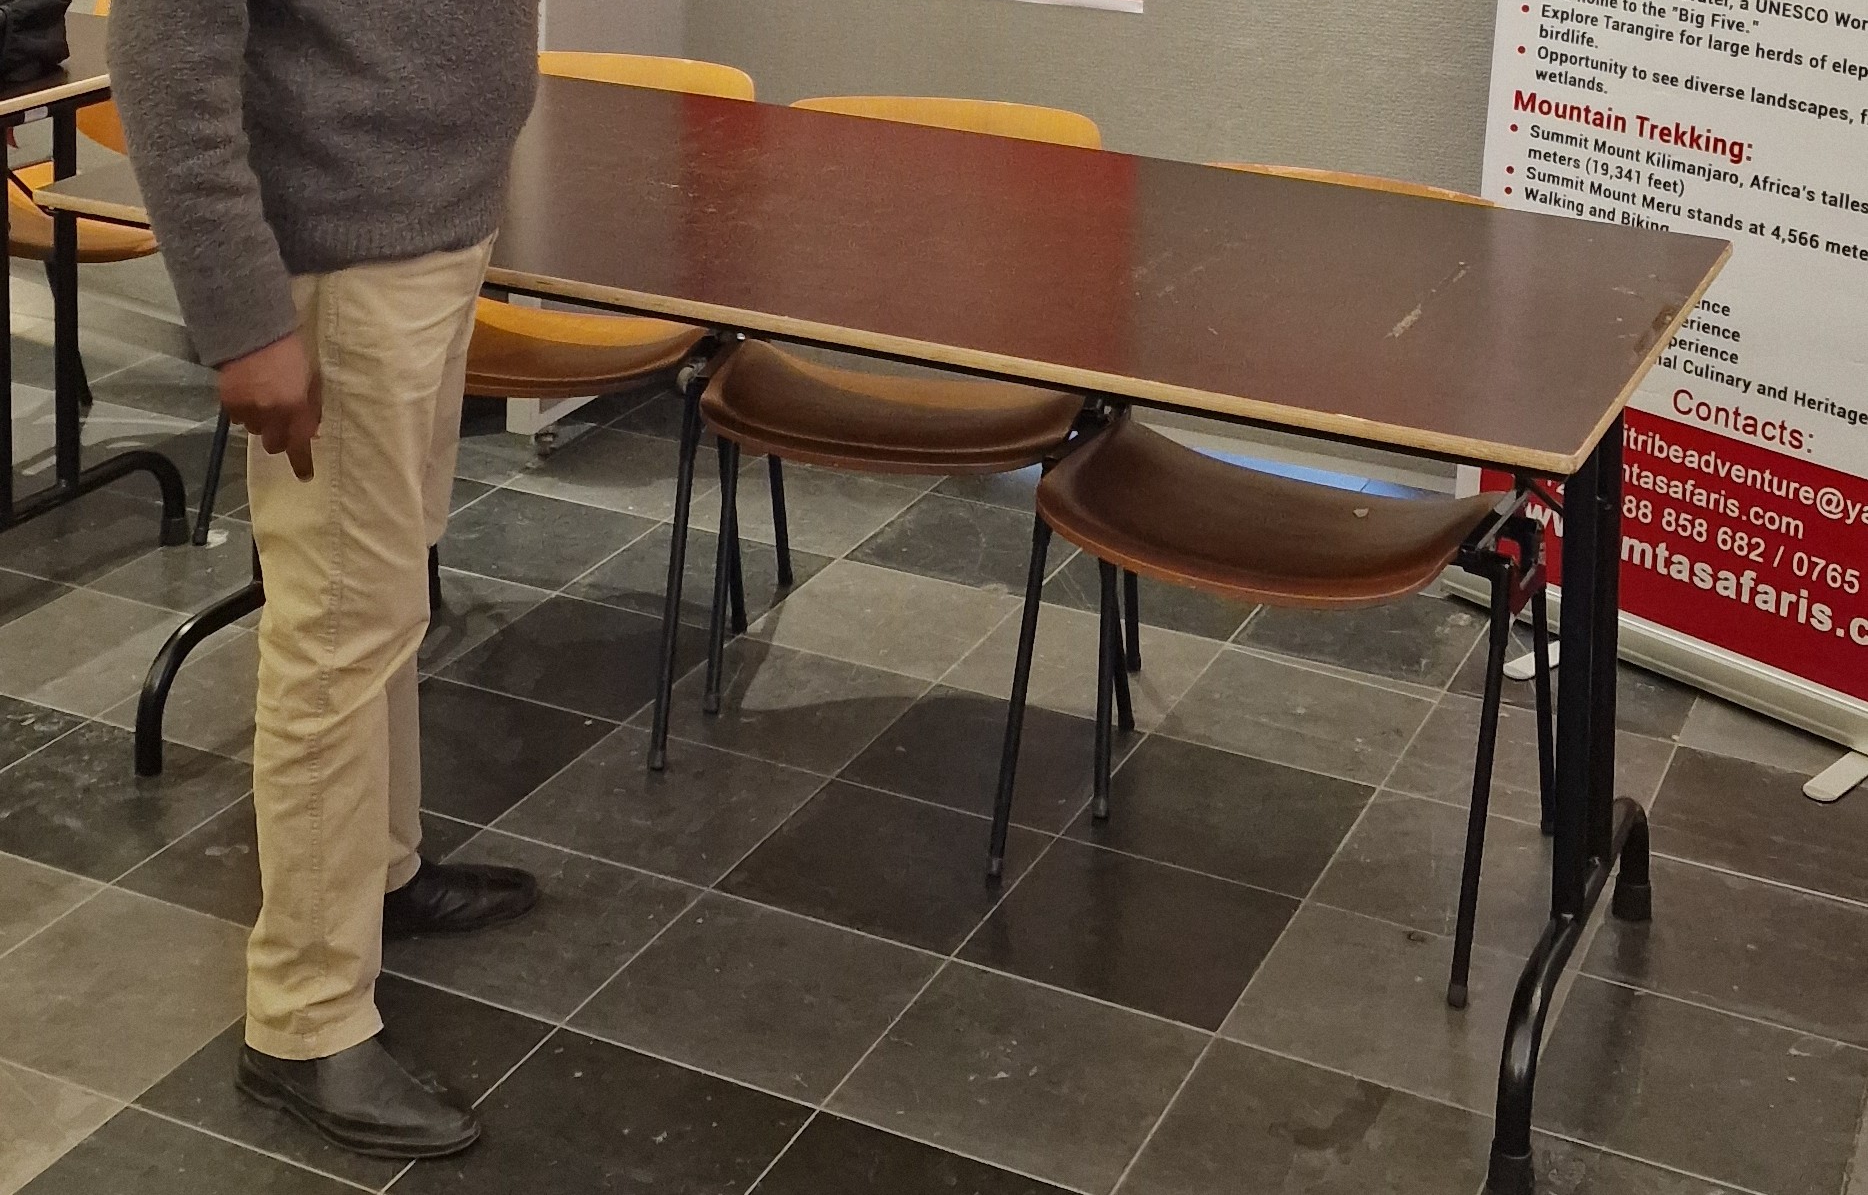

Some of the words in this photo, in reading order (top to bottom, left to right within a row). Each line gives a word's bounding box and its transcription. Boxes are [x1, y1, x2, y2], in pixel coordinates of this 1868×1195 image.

[1539, 24, 1599, 50] birdlife.
[1541, 5, 1598, 27] Explore
[1604, 15, 1674, 42] Tarangire
[1679, 30, 1703, 48] for
[1708, 35, 1750, 58] large
[1756, 42, 1803, 66] herds
[1809, 55, 1829, 72] of
[1832, 58, 1868, 81] elep
[1642, 1, 1666, 19] the
[1671, 6, 1705, 29] "Big
[1739, 0, 1750, 12] a
[1835, 11, 1868, 31] Wor
[1536, 69, 1608, 94] wetlands.
[1537, 45, 1628, 79] Opportunity
[1632, 65, 1648, 81] to
[1652, 71, 1679, 87] see
[1684, 75, 1745, 101] diverse
[1751, 87, 1854, 124] landscapes,
[1513, 89, 1627, 134] Mountain
[1635, 115, 1753, 165] Trekking:
[1528, 147, 1581, 169] meters
[1585, 157, 1642, 186] (19,341
[1647, 173, 1685, 198] feet)
[1530, 124, 1590, 150] Summit
[1593, 138, 1641, 163] Mount
[1646, 151, 1744, 189] Kilimanjaro,
[1750, 174, 1816, 203] Africa's
[1821, 190, 1868, 214] talles
[1524, 186, 1584, 216] Walking
[1589, 205, 1616, 222] and
[1526, 166, 1585, 193] Summit
[1589, 181, 1637, 206] Mount
[1642, 194, 1682, 217] Meru
[1686, 206, 1744, 232] stands
[1748, 222, 1766, 237] at
[1770, 225, 1820, 249] 4,566
[1825, 240, 1868, 261] mete
[1668, 336, 1738, 364] perience
[1681, 316, 1740, 342] erience
[1672, 388, 1814, 454] Contacts:
[1683, 360, 1752, 393] Culinary
[1756, 381, 1788, 402] and
[1794, 390, 1868, 426] Heritage
[1623, 423, 1868, 525] itribeadventure@ya
[1623, 463, 1804, 540] tasafaris.com
[1622, 495, 1652, 524] 88
[1661, 507, 1708, 543] 858
[1716, 524, 1765, 564] 682
[1792, 551, 1860, 594] 0765
[1620, 535, 1868, 646] mtasafaris.c
